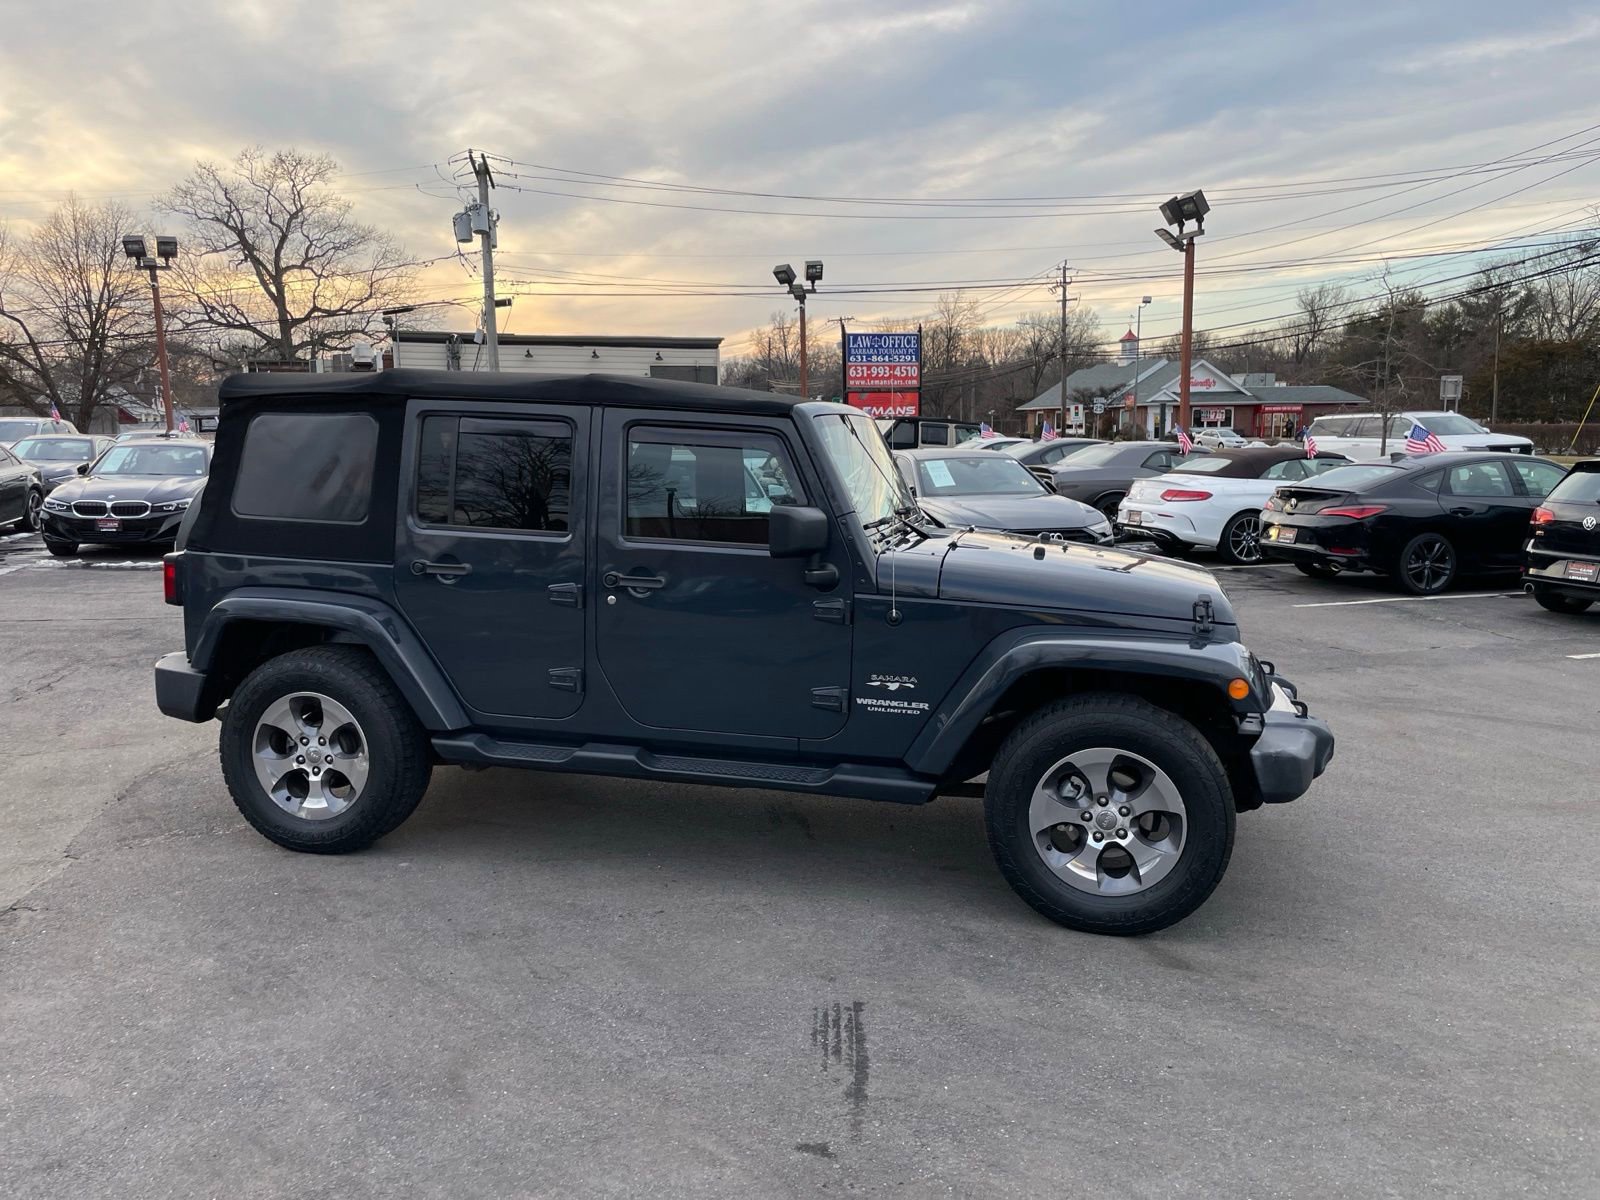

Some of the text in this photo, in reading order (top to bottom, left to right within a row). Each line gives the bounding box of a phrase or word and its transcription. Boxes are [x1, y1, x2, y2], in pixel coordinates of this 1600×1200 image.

[850, 336, 917, 348] LAW OFFICE
[871, 674, 918, 683] SAHARA
[856, 698, 930, 710] WRANGLER
[867, 706, 920, 714] UNLIMITED
